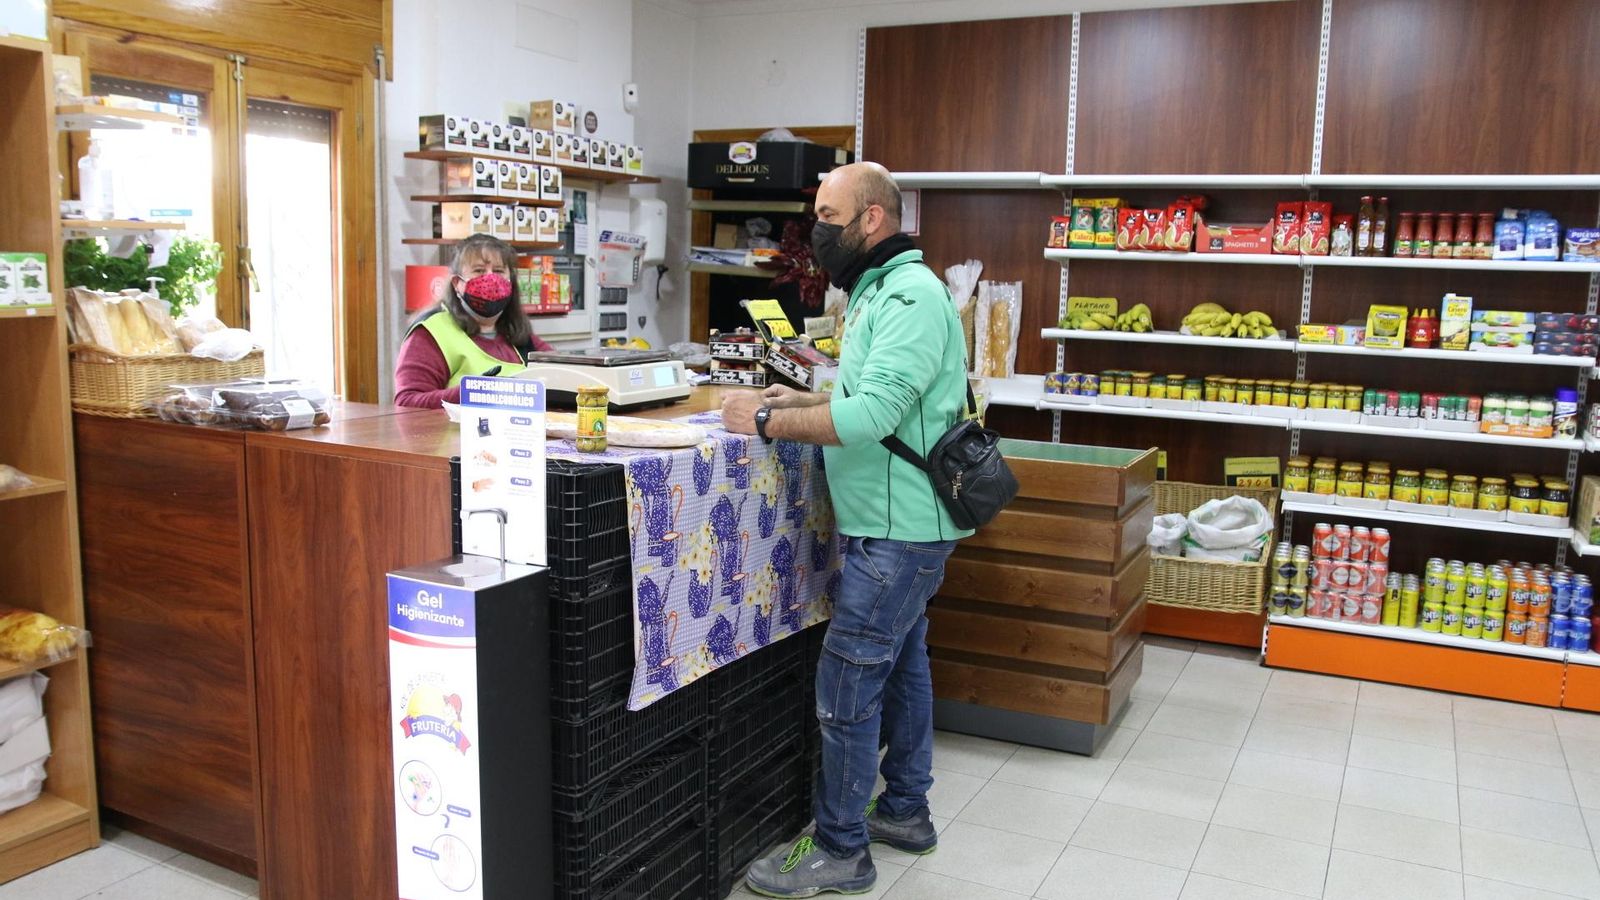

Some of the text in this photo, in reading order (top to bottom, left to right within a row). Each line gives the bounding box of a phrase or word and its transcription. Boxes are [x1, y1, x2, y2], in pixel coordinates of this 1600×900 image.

[716, 164, 769, 174] DELICIOUS
[465, 379, 539, 395] DISPENSADOR DE GEL
[417, 589, 443, 609] Gel
[396, 603, 465, 628] Higienizante
